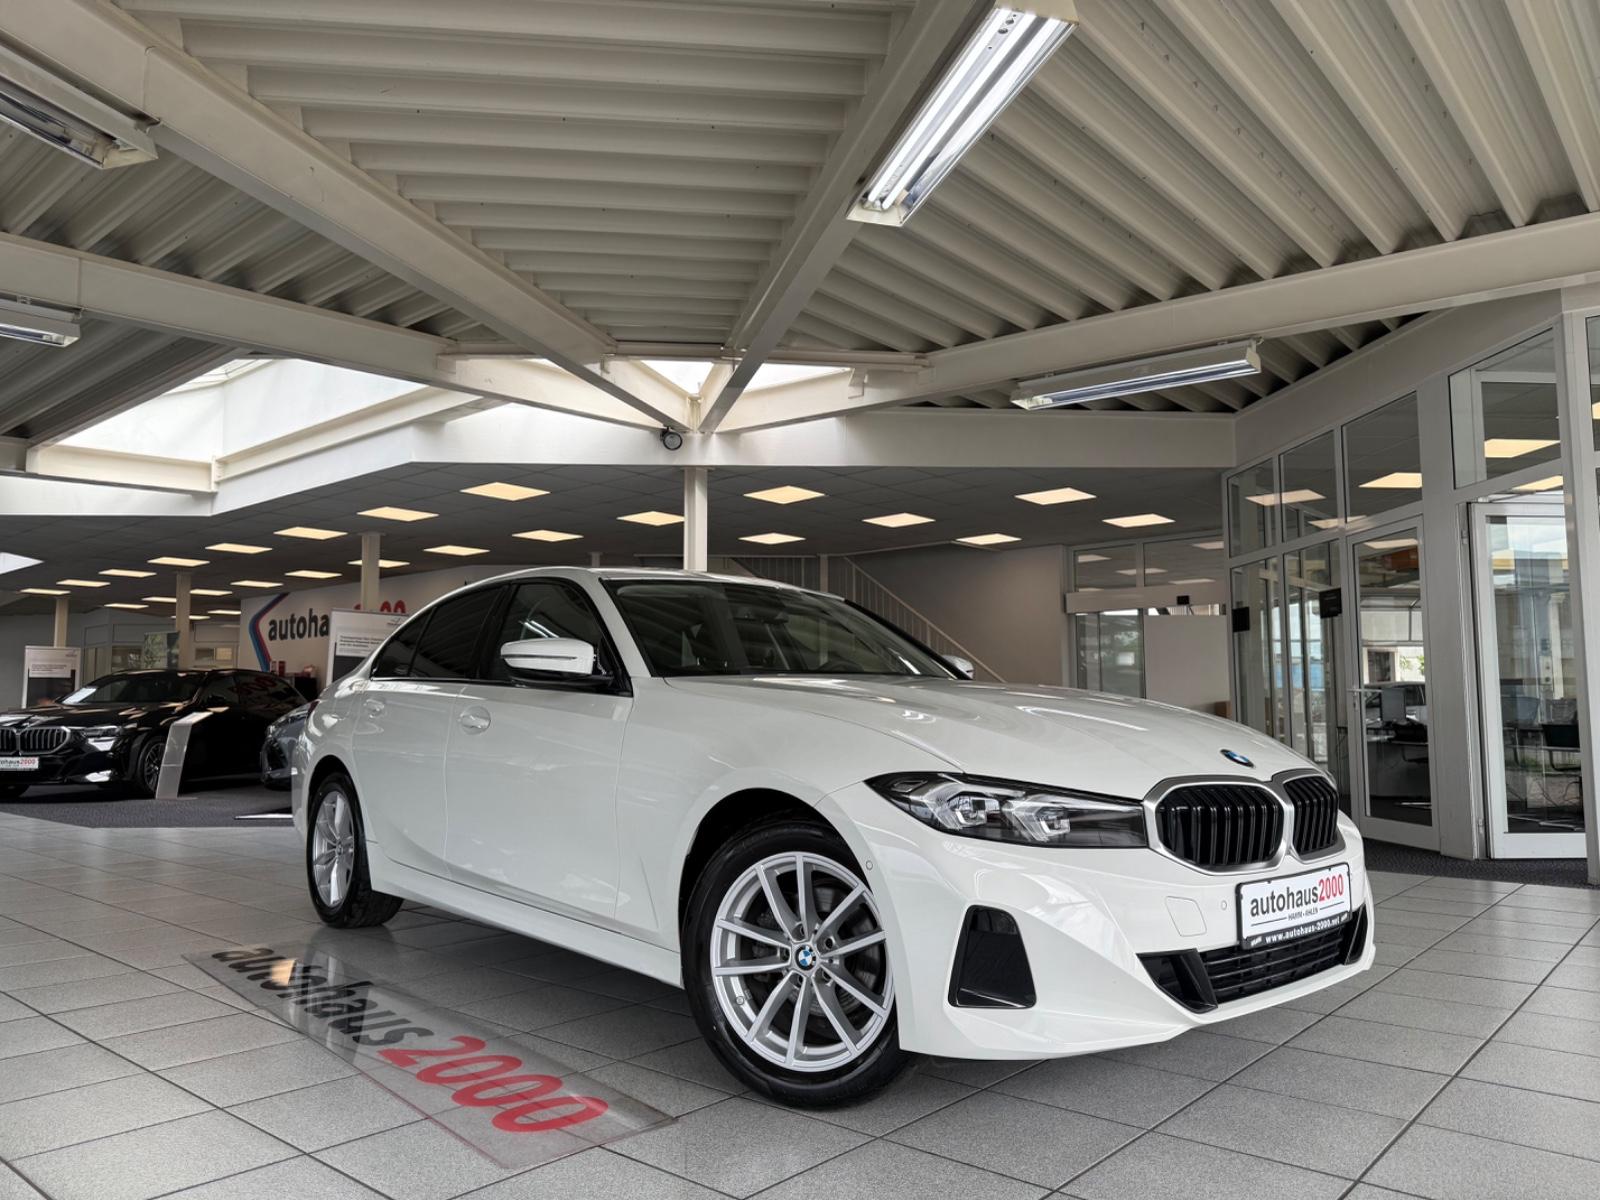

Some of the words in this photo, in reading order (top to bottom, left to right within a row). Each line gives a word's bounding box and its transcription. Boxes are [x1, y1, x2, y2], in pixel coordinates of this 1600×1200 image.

[268, 608, 330, 641] autoha
[1250, 874, 1344, 917] autohaus2000
[1265, 916, 1340, 944] www.autohaus-2000.net
